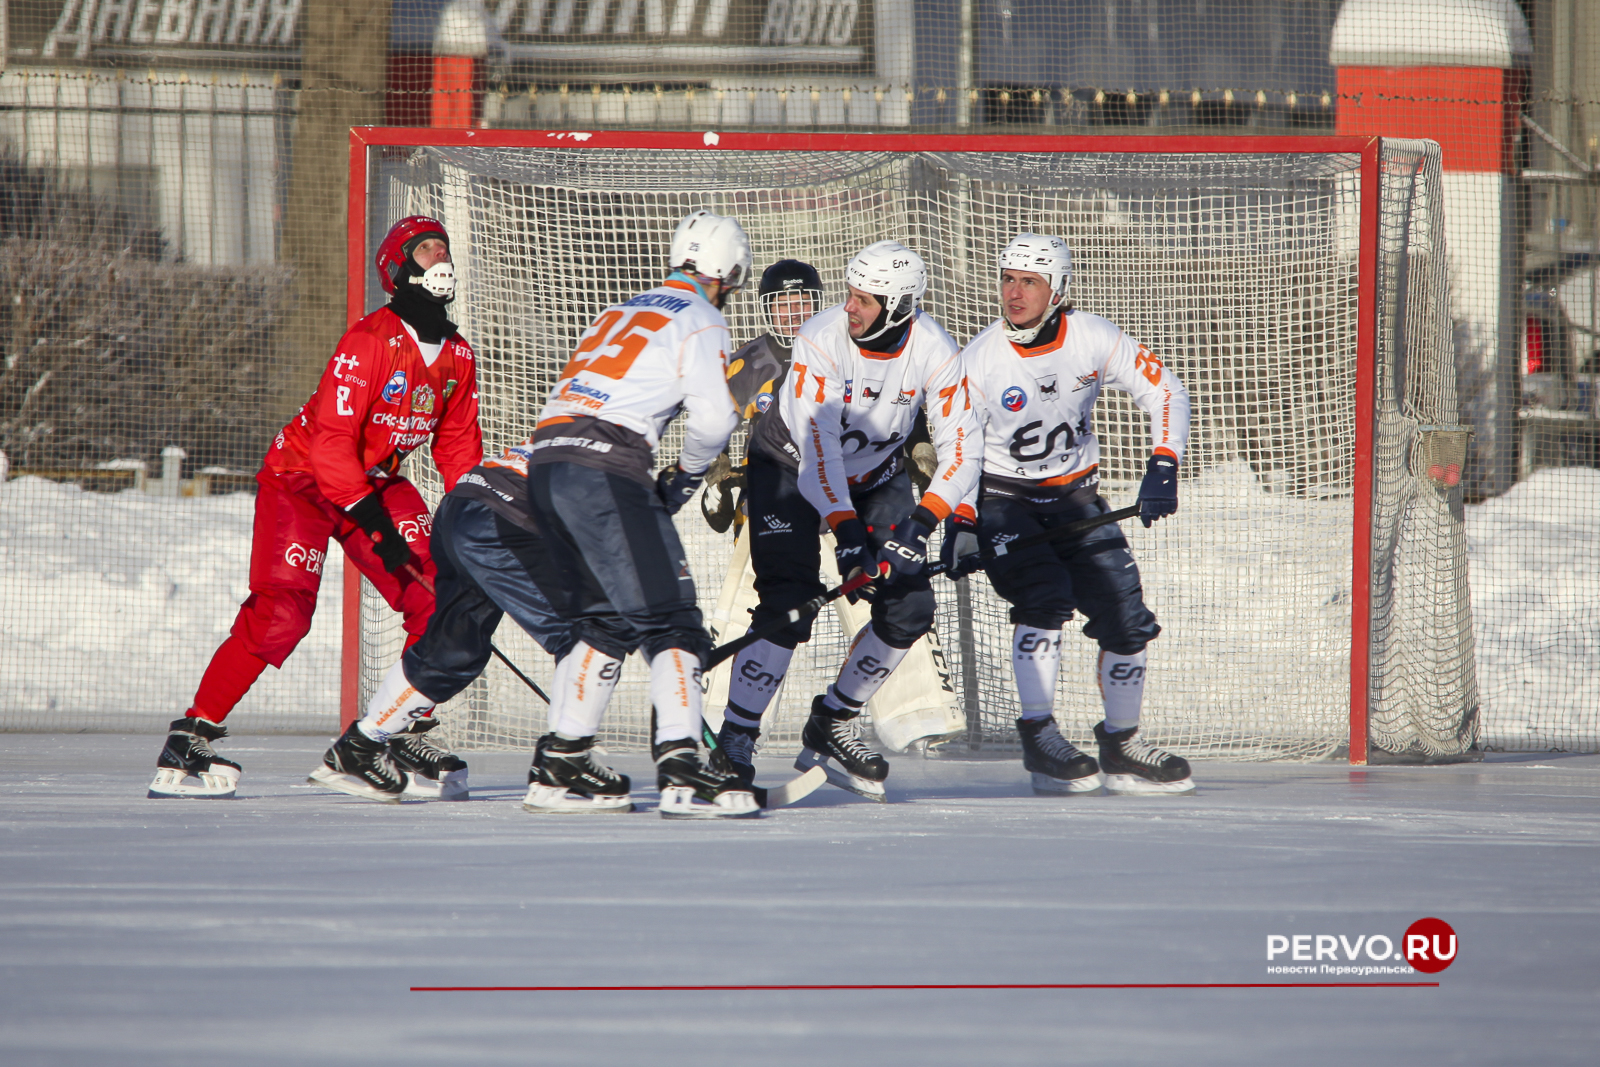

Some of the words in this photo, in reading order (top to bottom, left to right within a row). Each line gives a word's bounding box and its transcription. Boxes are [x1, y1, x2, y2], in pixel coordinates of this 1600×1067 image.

[892, 258, 910, 269] En+
[782, 278, 804, 286] Reebok
[558, 310, 673, 380] 25
[344, 373, 367, 388] group
[793, 361, 827, 404] 77
[336, 384, 354, 416] 8
[938, 375, 971, 418] 77
[883, 540, 926, 564] CCM
